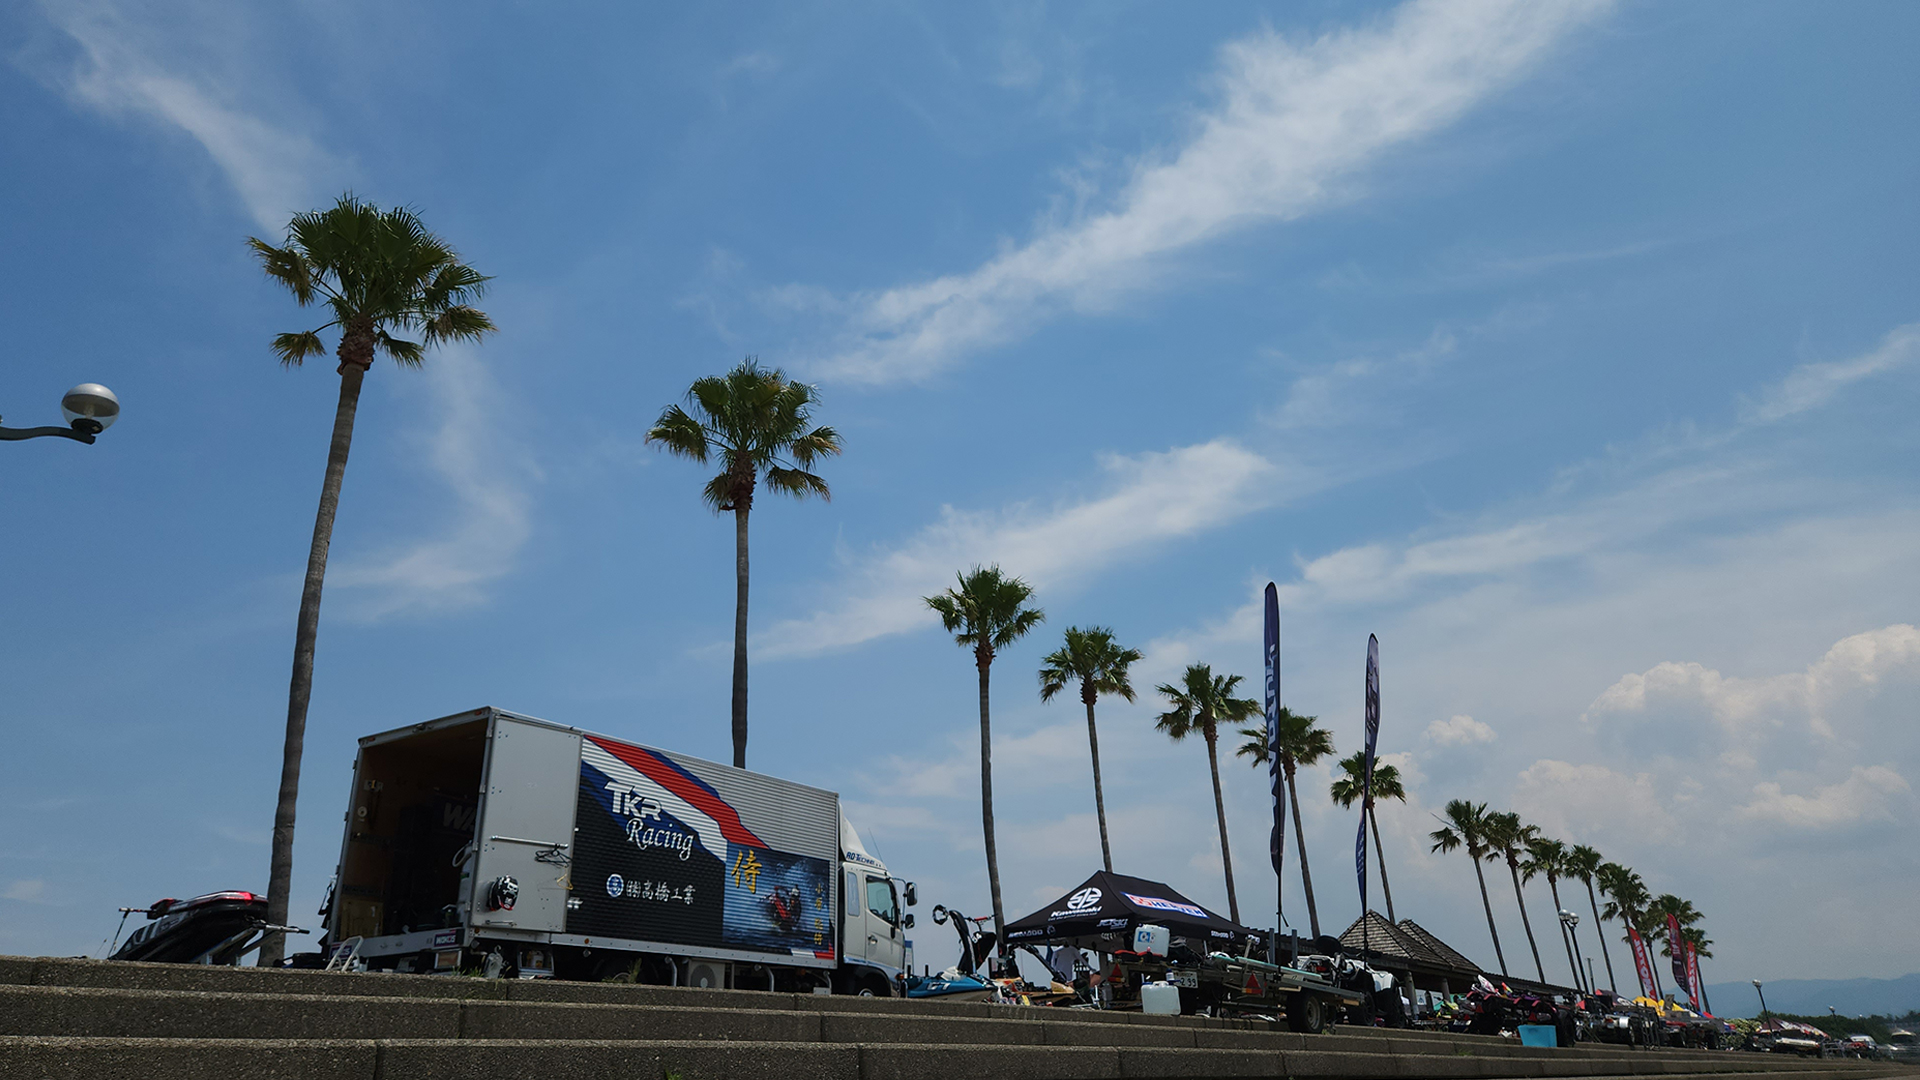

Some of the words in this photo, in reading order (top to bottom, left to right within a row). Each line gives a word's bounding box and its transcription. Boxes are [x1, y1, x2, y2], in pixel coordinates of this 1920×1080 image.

[604, 781, 661, 821] TKR
[626, 818, 694, 861] Racing
[731, 850, 762, 894] 侍
[1050, 906, 1102, 918] Kawasaki
